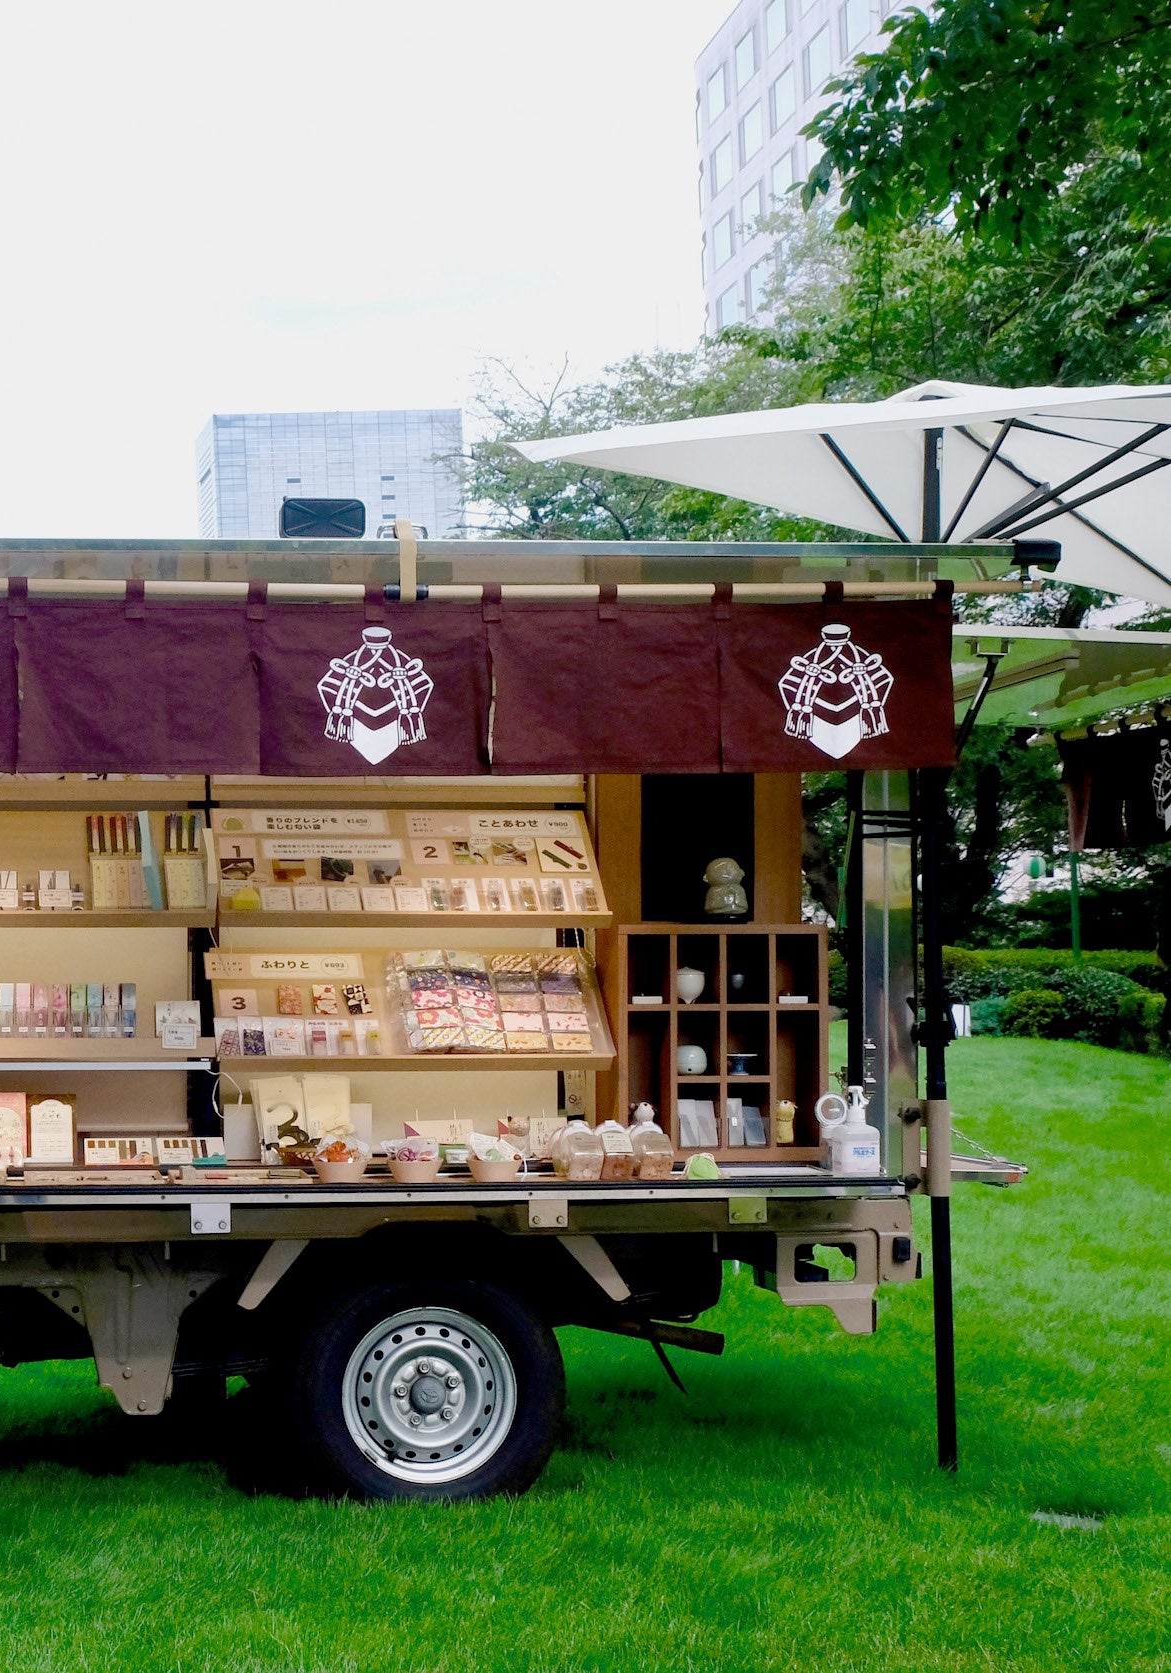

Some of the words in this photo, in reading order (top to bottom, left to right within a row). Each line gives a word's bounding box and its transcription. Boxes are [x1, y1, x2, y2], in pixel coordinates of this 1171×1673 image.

[478, 819, 539, 828] ことあわせ
[422, 846, 439, 859] 2
[261, 960, 310, 969] ふわりと
[231, 997, 247, 1010] 3
